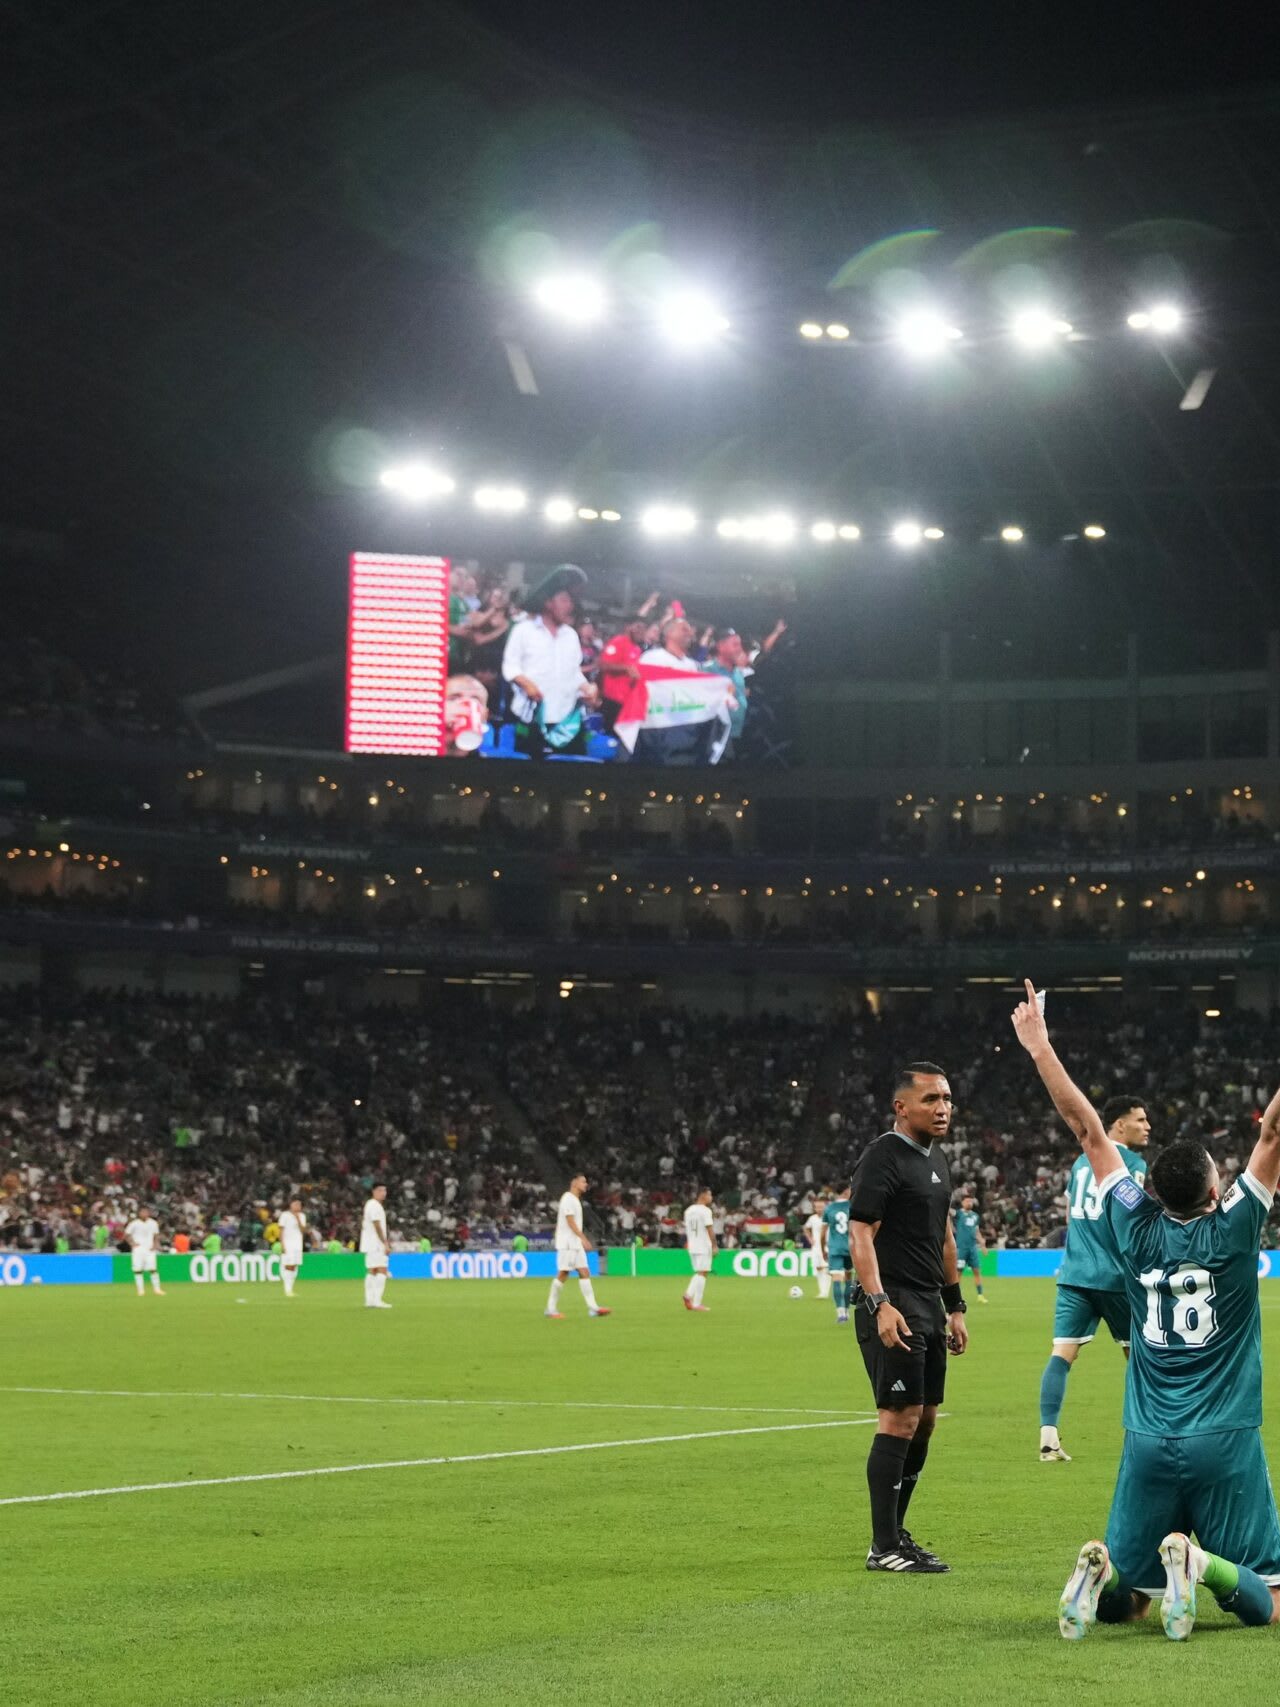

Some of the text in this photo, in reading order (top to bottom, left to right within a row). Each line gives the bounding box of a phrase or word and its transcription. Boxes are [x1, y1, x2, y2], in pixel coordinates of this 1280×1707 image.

[1127, 948, 1254, 962] MONTERREY
[1071, 1166, 1104, 1220] 15
[835, 1211, 849, 1235] 3
[189, 1254, 281, 1283] aramc
[431, 1252, 529, 1279] aramco
[1136, 1263, 1220, 1347] 18
